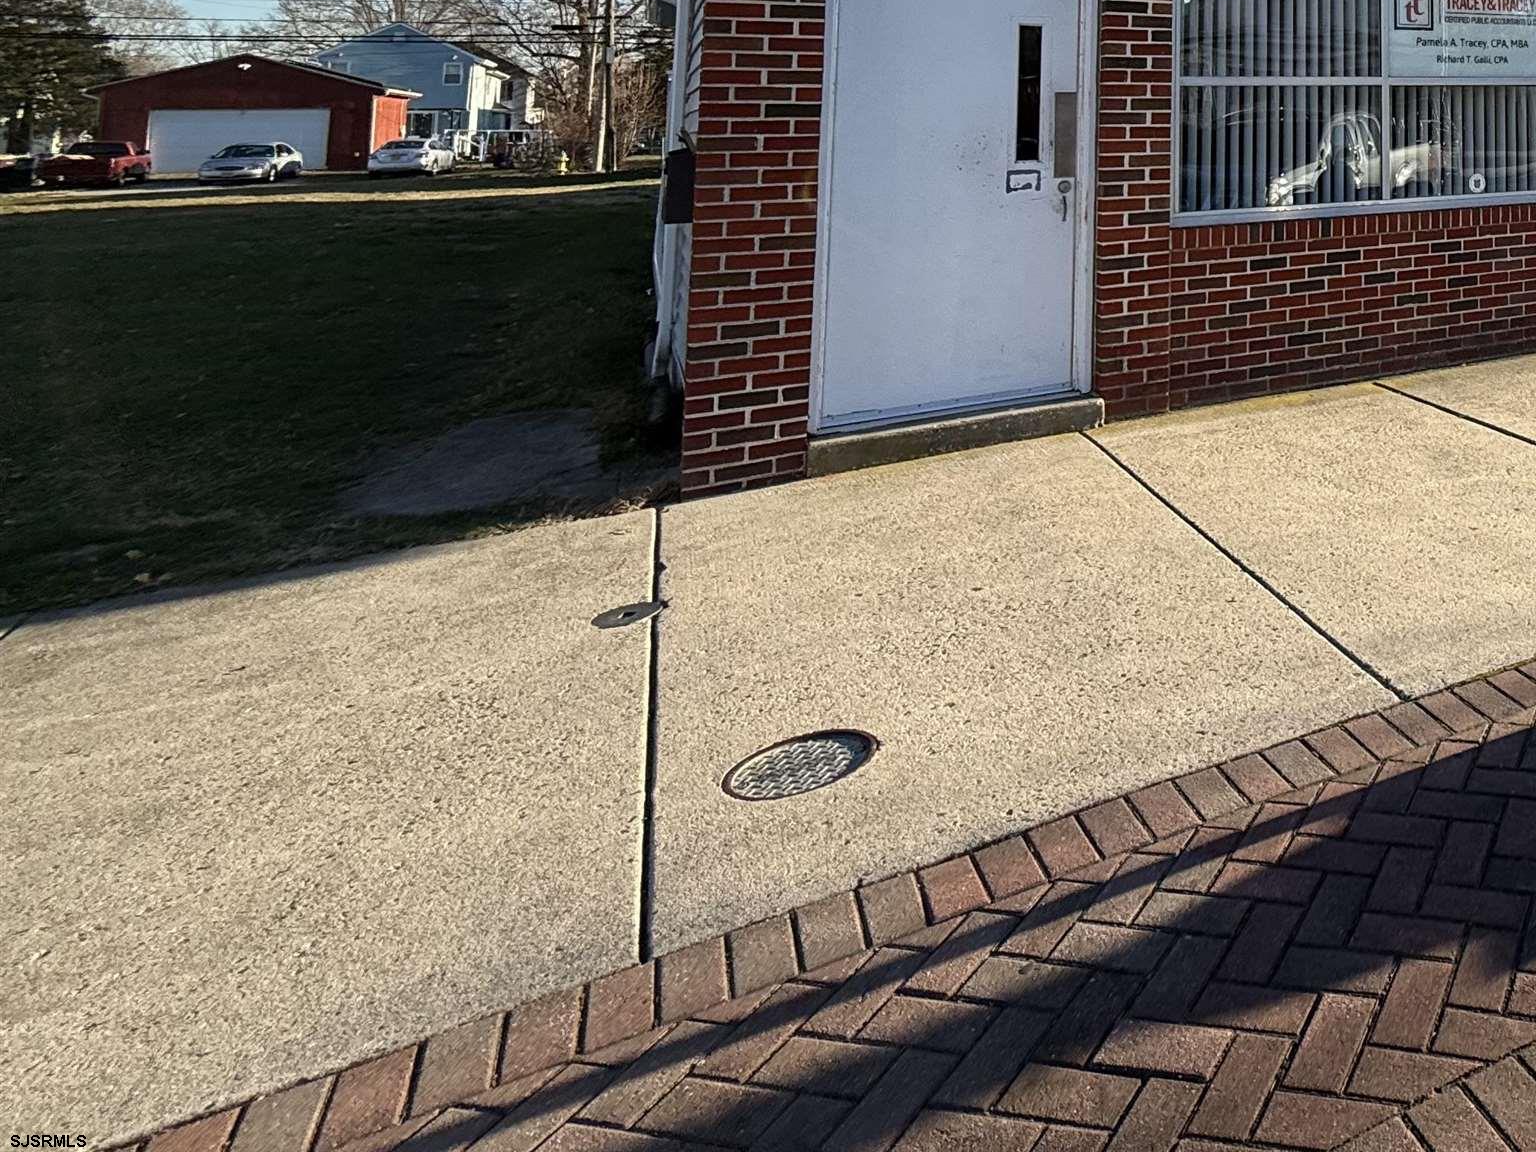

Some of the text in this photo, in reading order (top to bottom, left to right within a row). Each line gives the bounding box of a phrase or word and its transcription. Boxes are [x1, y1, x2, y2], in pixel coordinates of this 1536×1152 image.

[1415, 36, 1449, 48] Pamela
[1510, 39, 1529, 48] MBA
[1436, 54, 1465, 64] Richard
[1493, 55, 1509, 65] CPA
